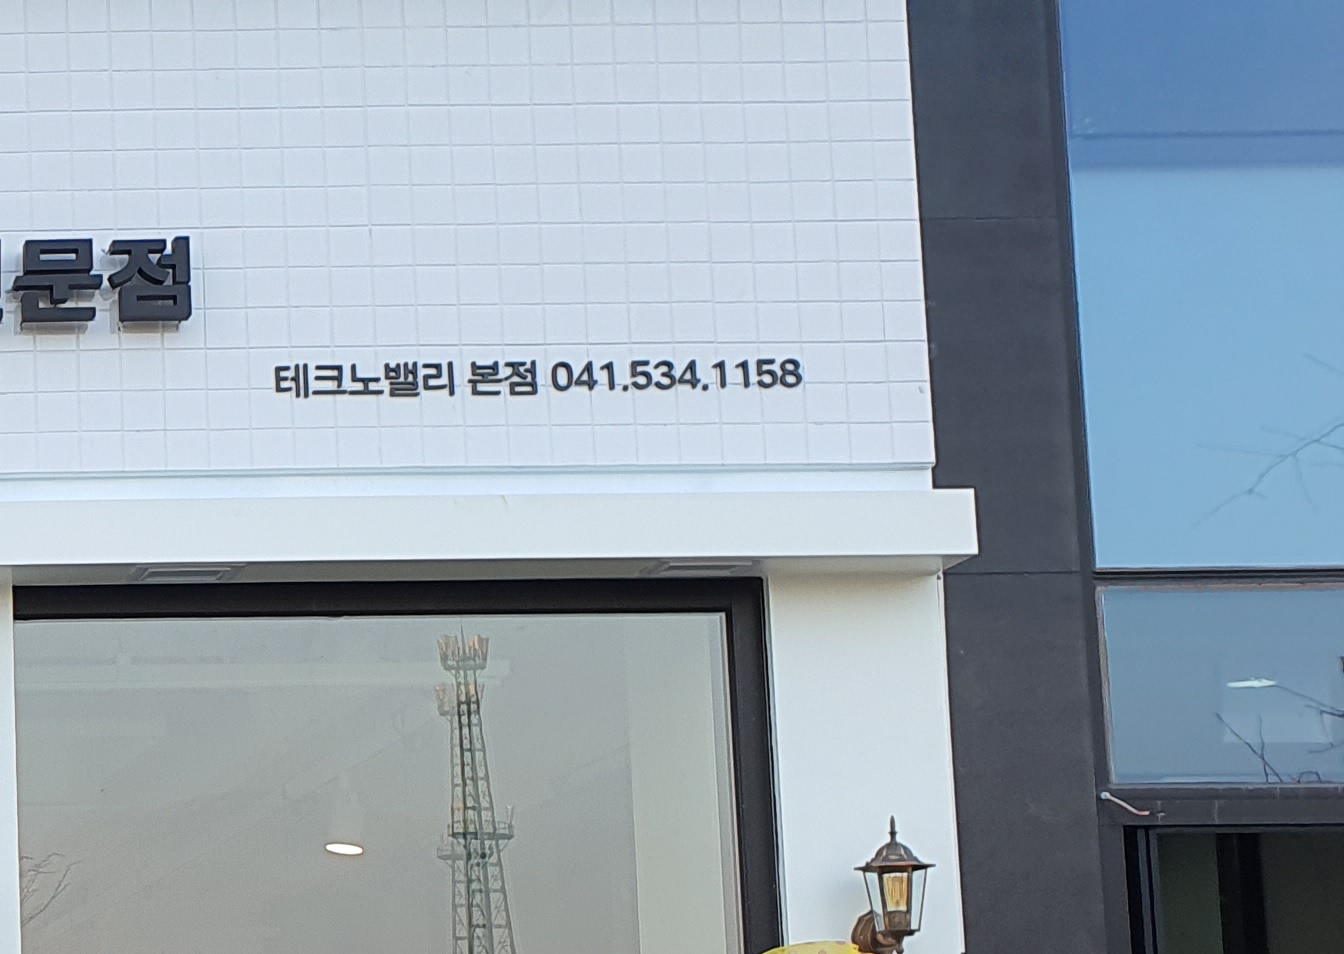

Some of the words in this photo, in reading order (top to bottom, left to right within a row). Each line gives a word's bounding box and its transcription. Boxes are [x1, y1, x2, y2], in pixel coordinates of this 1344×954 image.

[273, 360, 456, 399] 테크노밸리
[466, 359, 539, 397] 본점
[551, 357, 804, 393] 041.534.1158
